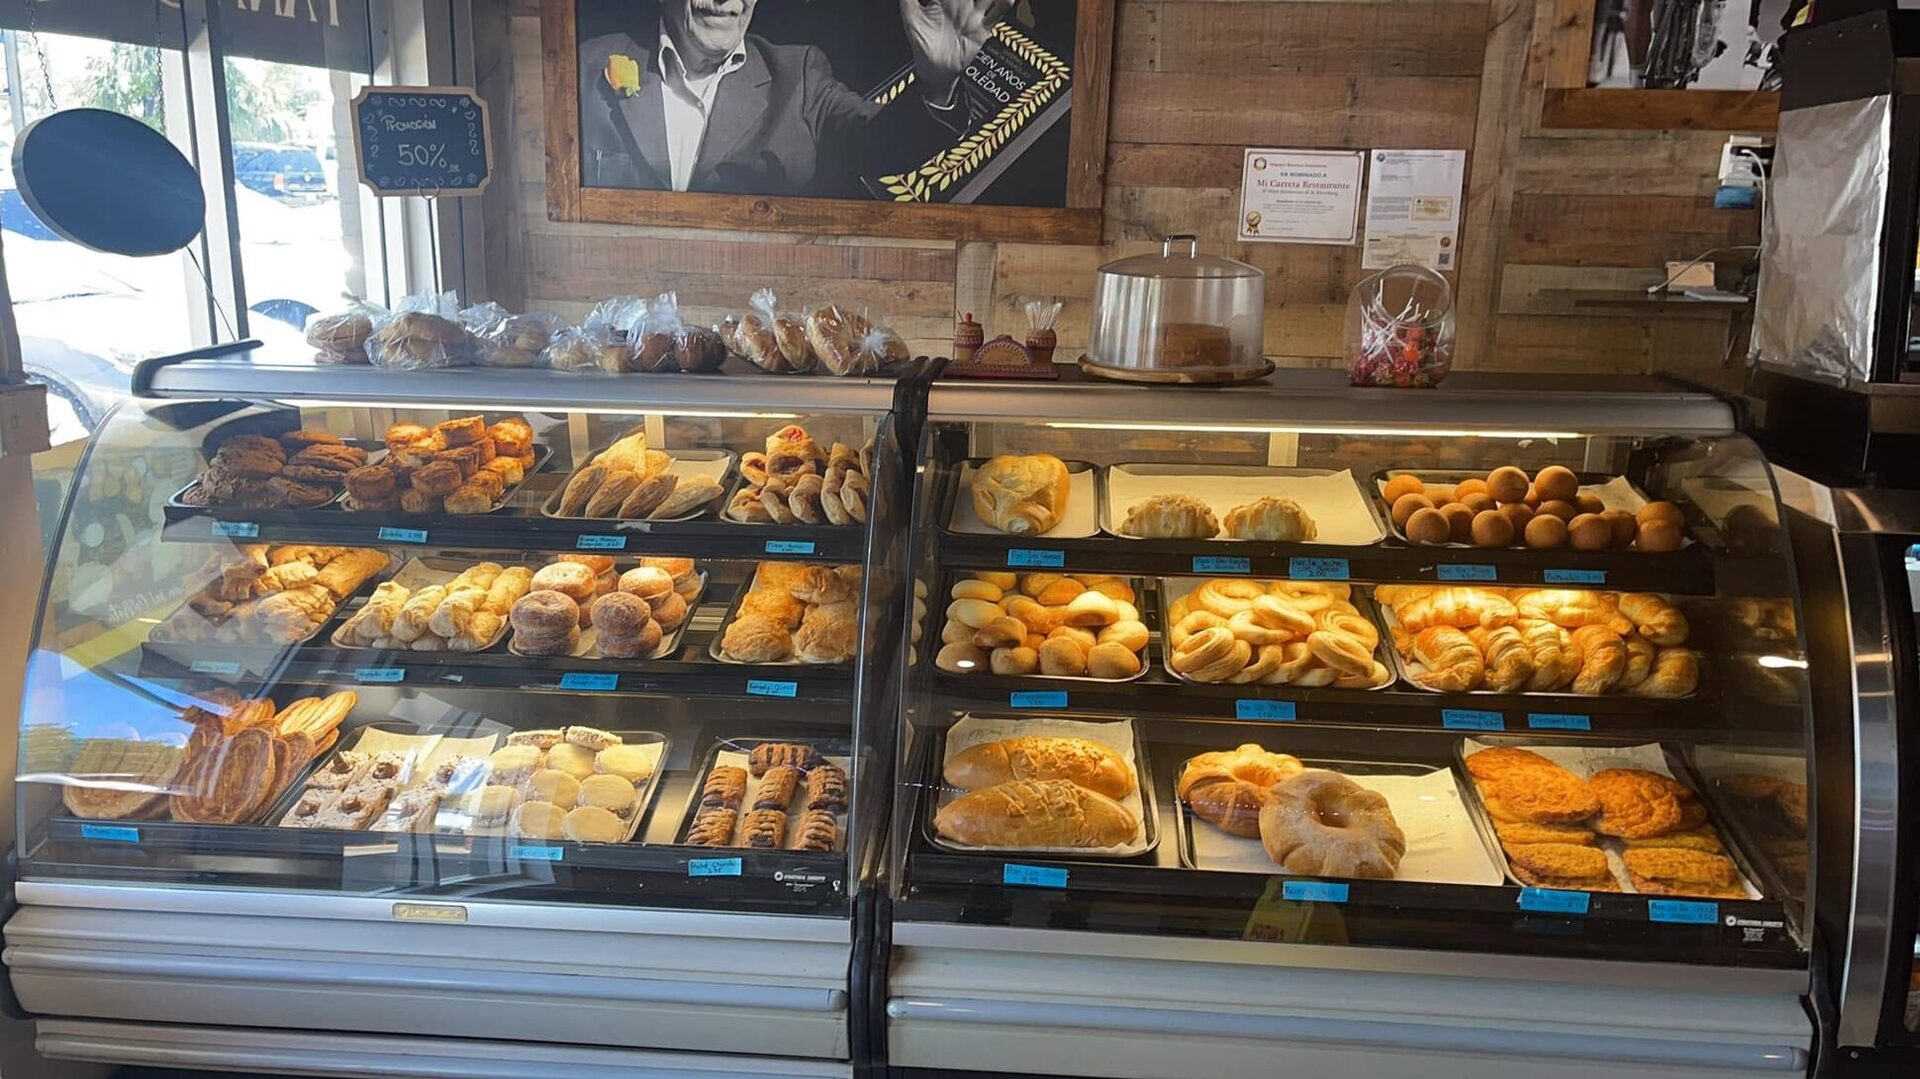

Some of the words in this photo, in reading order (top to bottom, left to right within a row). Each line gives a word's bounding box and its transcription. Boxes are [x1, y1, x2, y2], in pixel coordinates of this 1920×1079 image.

[966, 66, 1010, 102] OLEDAD
[398, 143, 447, 167] 50%
[1257, 179, 1268, 187] Mi
[1269, 179, 1300, 188] Carreta
[1302, 181, 1350, 189] Restaurante
